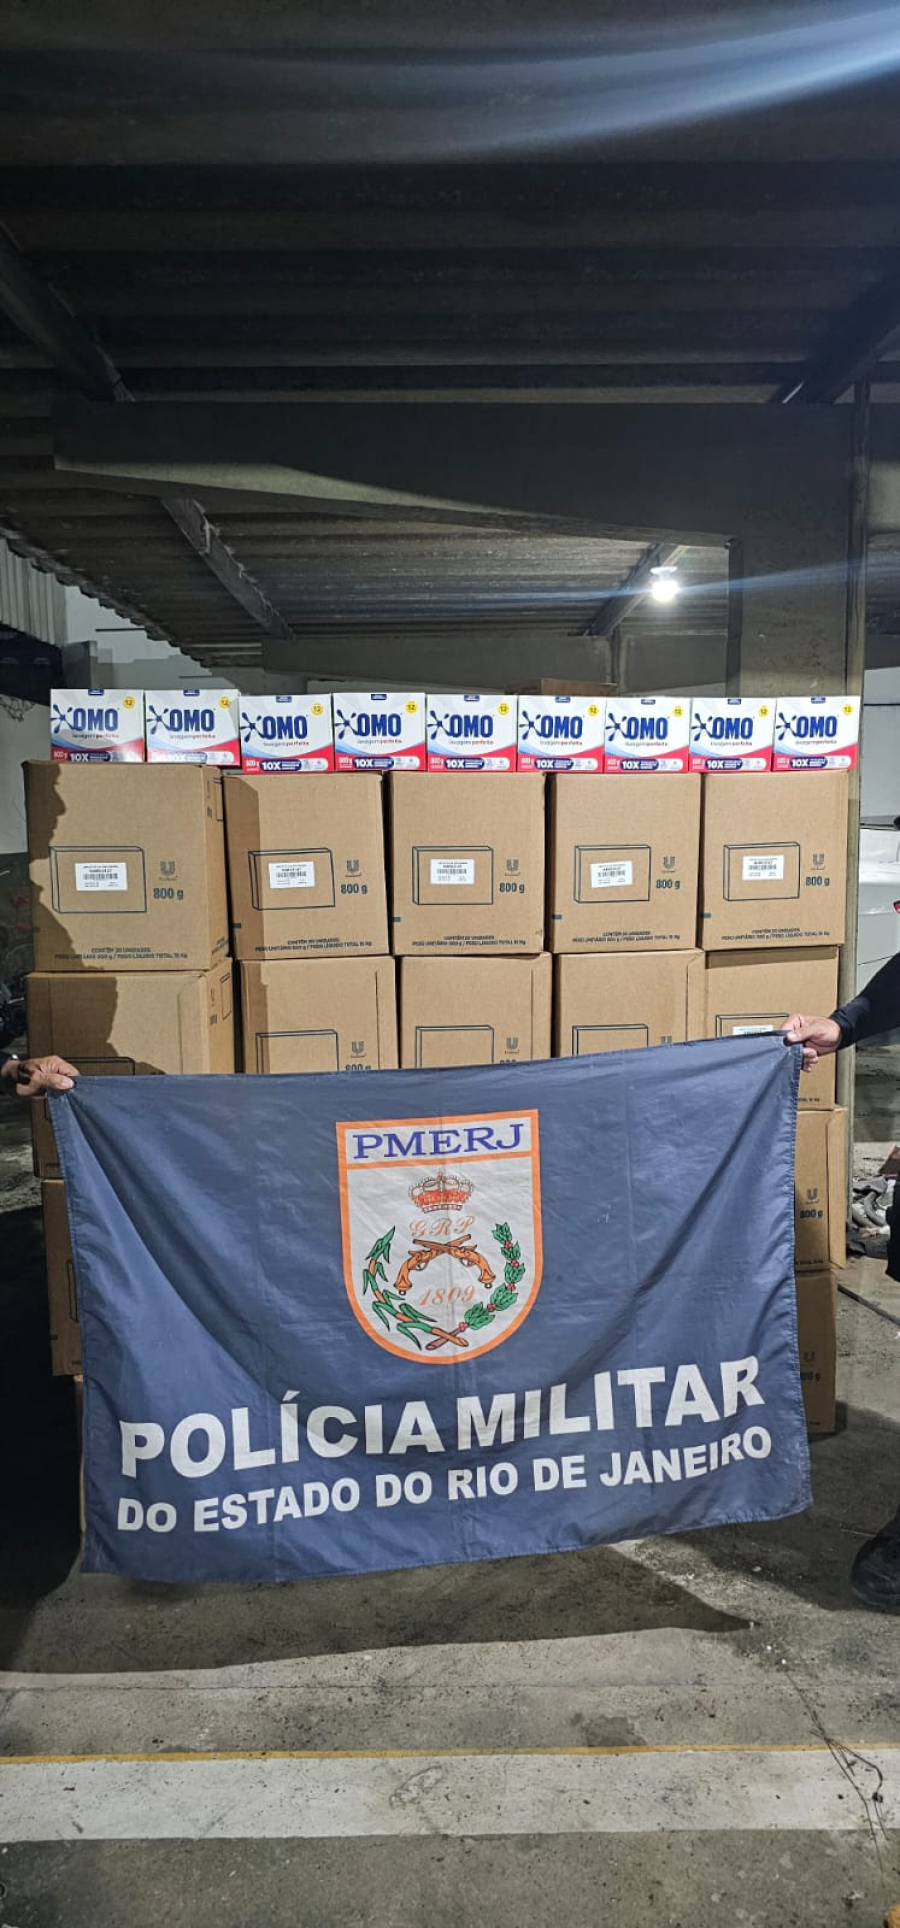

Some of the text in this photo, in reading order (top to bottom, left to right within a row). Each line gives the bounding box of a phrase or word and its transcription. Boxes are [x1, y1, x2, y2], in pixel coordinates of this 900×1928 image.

[73, 708, 118, 732] OMO
[170, 709, 214, 732] OMO
[357, 713, 402, 736] OMO
[450, 714, 493, 738] OMO
[263, 716, 307, 740] OMO
[541, 715, 583, 738] OMO
[626, 716, 668, 740] OMO
[712, 716, 753, 740] OMO
[796, 716, 837, 738] OMO
[70, 753, 88, 762] 10X
[354, 759, 373, 768] 10X
[793, 758, 808, 768] 10X
[262, 762, 281, 770] 10X
[446, 760, 464, 769] 10X
[536, 760, 554, 769] 10X
[622, 760, 639, 770] 10X
[707, 760, 724, 770] 10X
[656, 879, 680, 890] 800 g
[806, 876, 830, 886] 800 g
[154, 888, 184, 900] 800 g
[340, 884, 367, 894] 800 g
[500, 882, 524, 894] 800 g
[353, 1124, 524, 1159] PMERJ
[800, 1210, 816, 1218] 800
[419, 1287, 476, 1305] 1809
[119, 1355, 765, 1479] POLÍCIA MILITAR
[117, 1425, 772, 1533] DO ESTADO DO RIO DE JANEIRO
